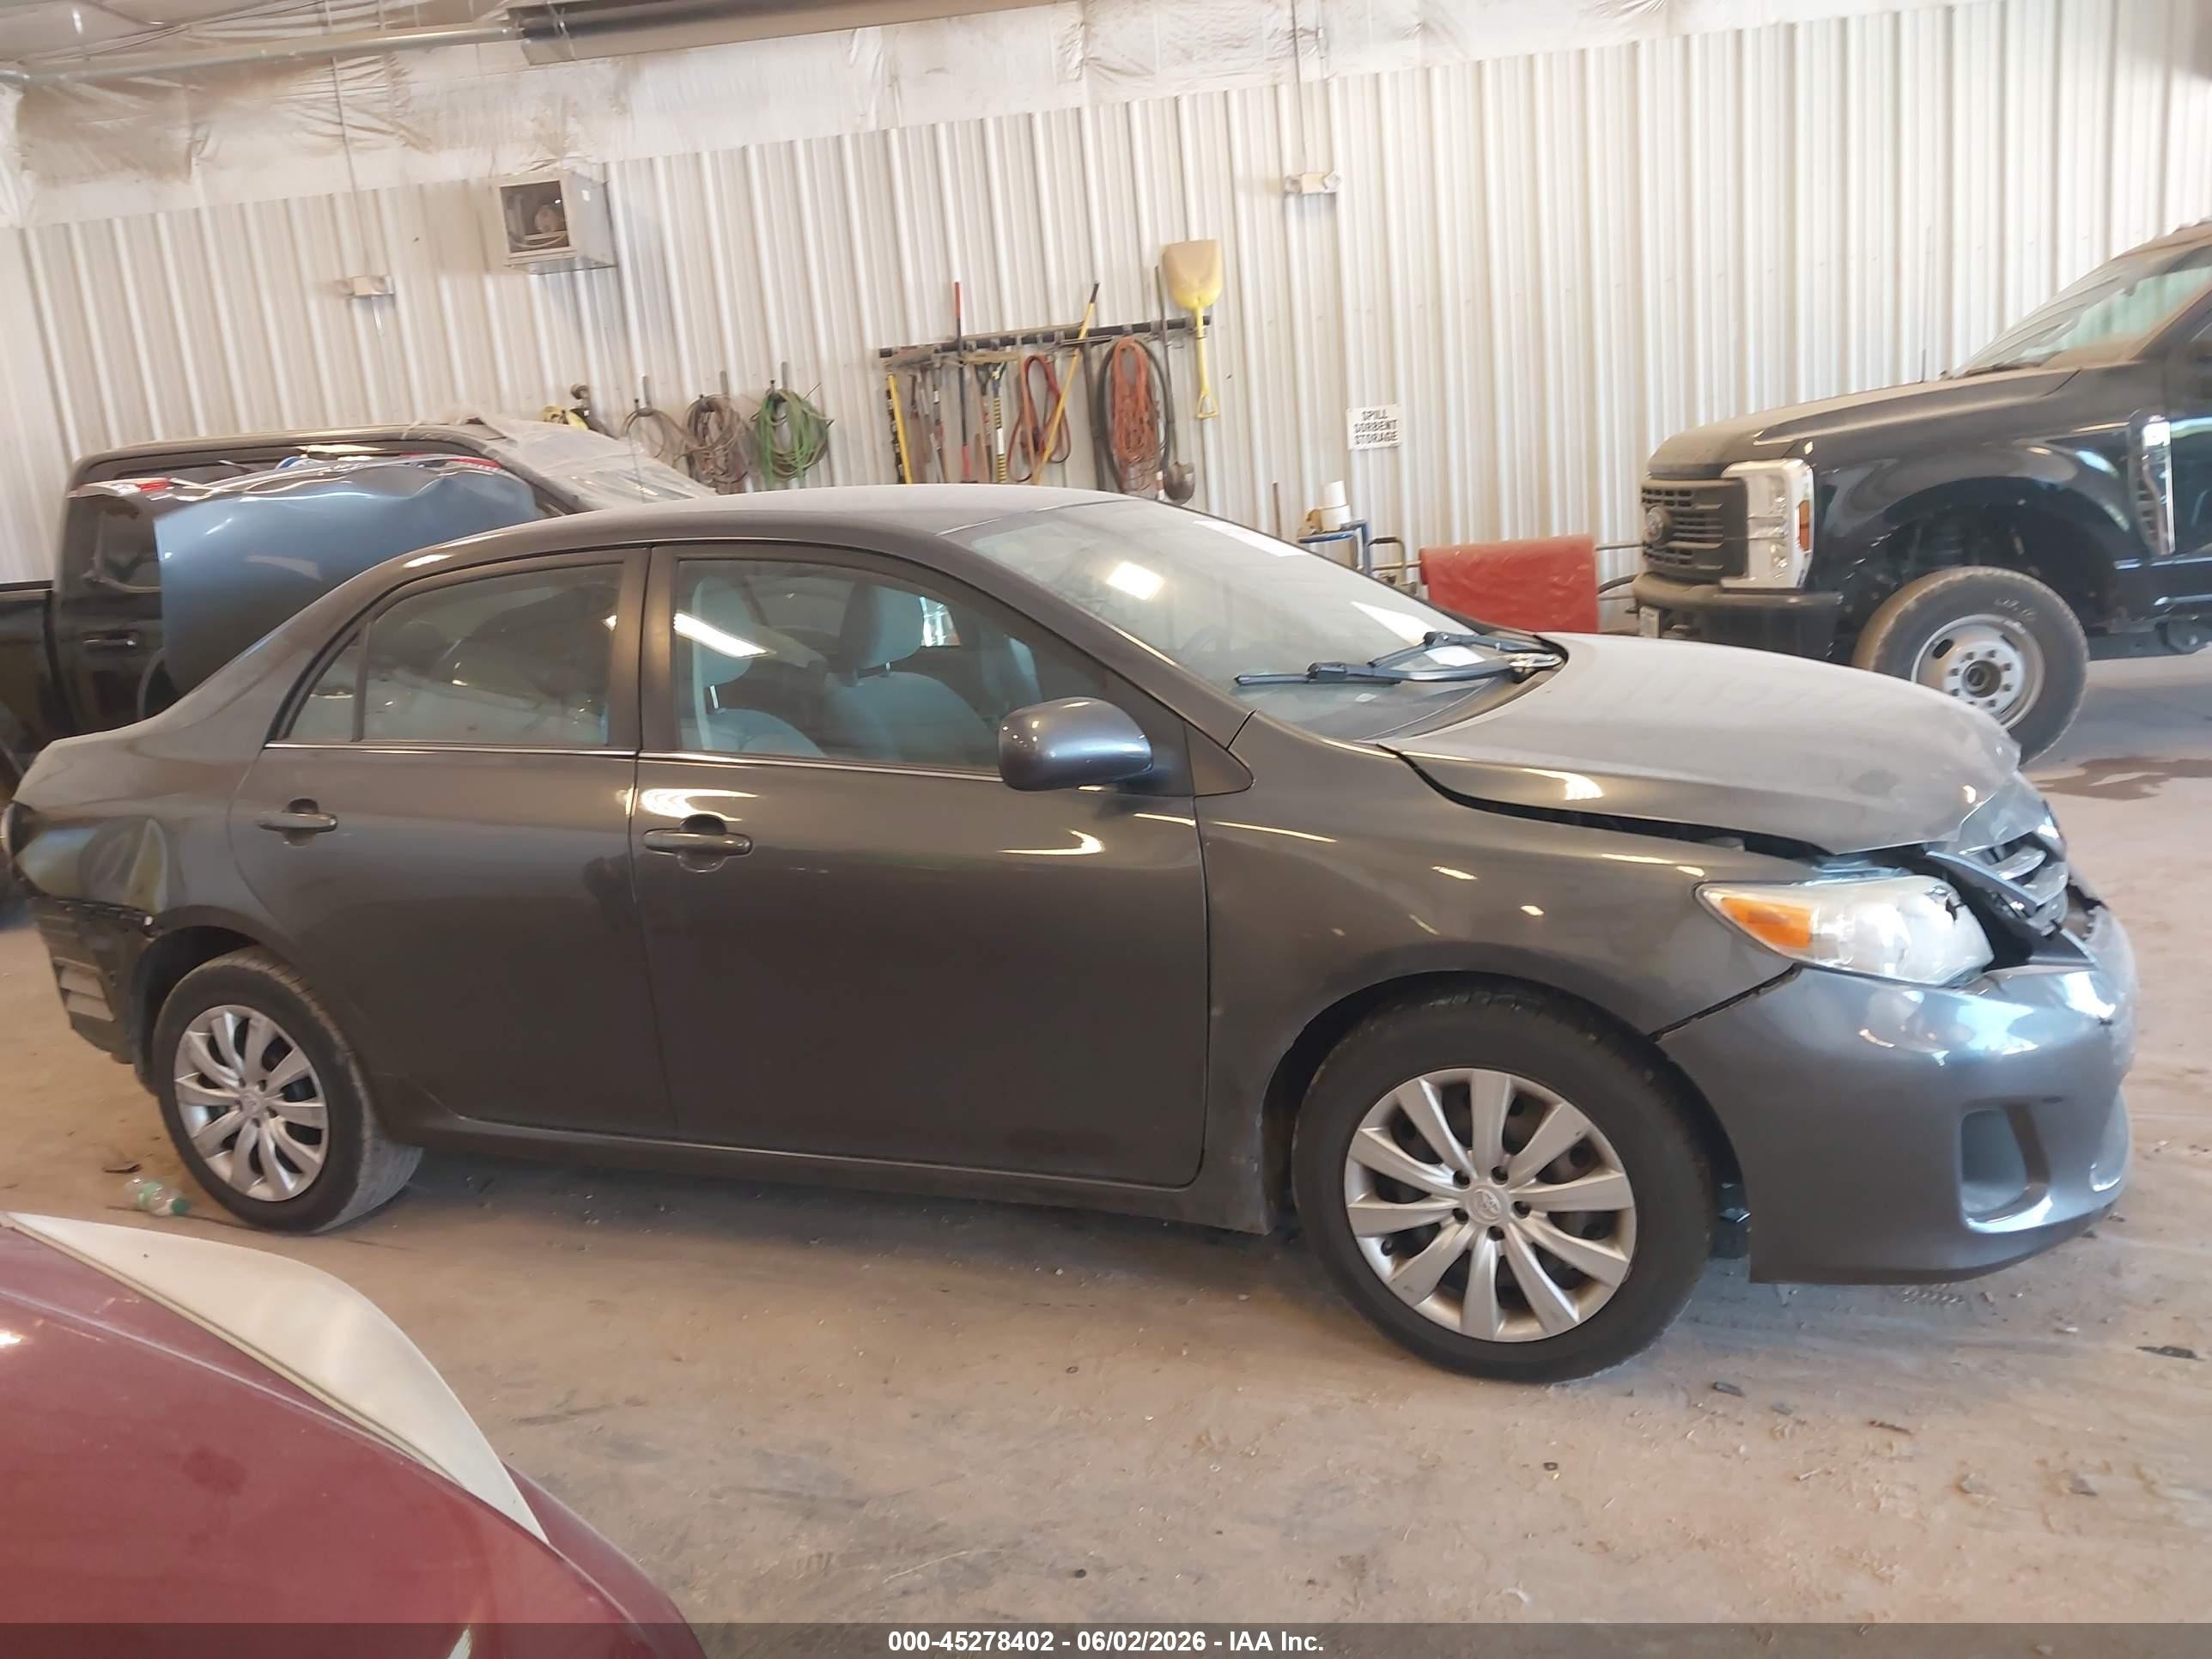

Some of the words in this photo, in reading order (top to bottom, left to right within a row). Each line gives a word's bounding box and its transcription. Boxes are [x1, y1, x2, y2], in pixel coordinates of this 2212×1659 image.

[1362, 409, 1388, 421] SPILL
[1354, 419, 1398, 434] SORBENT
[1354, 430, 1398, 445] STORAGE
